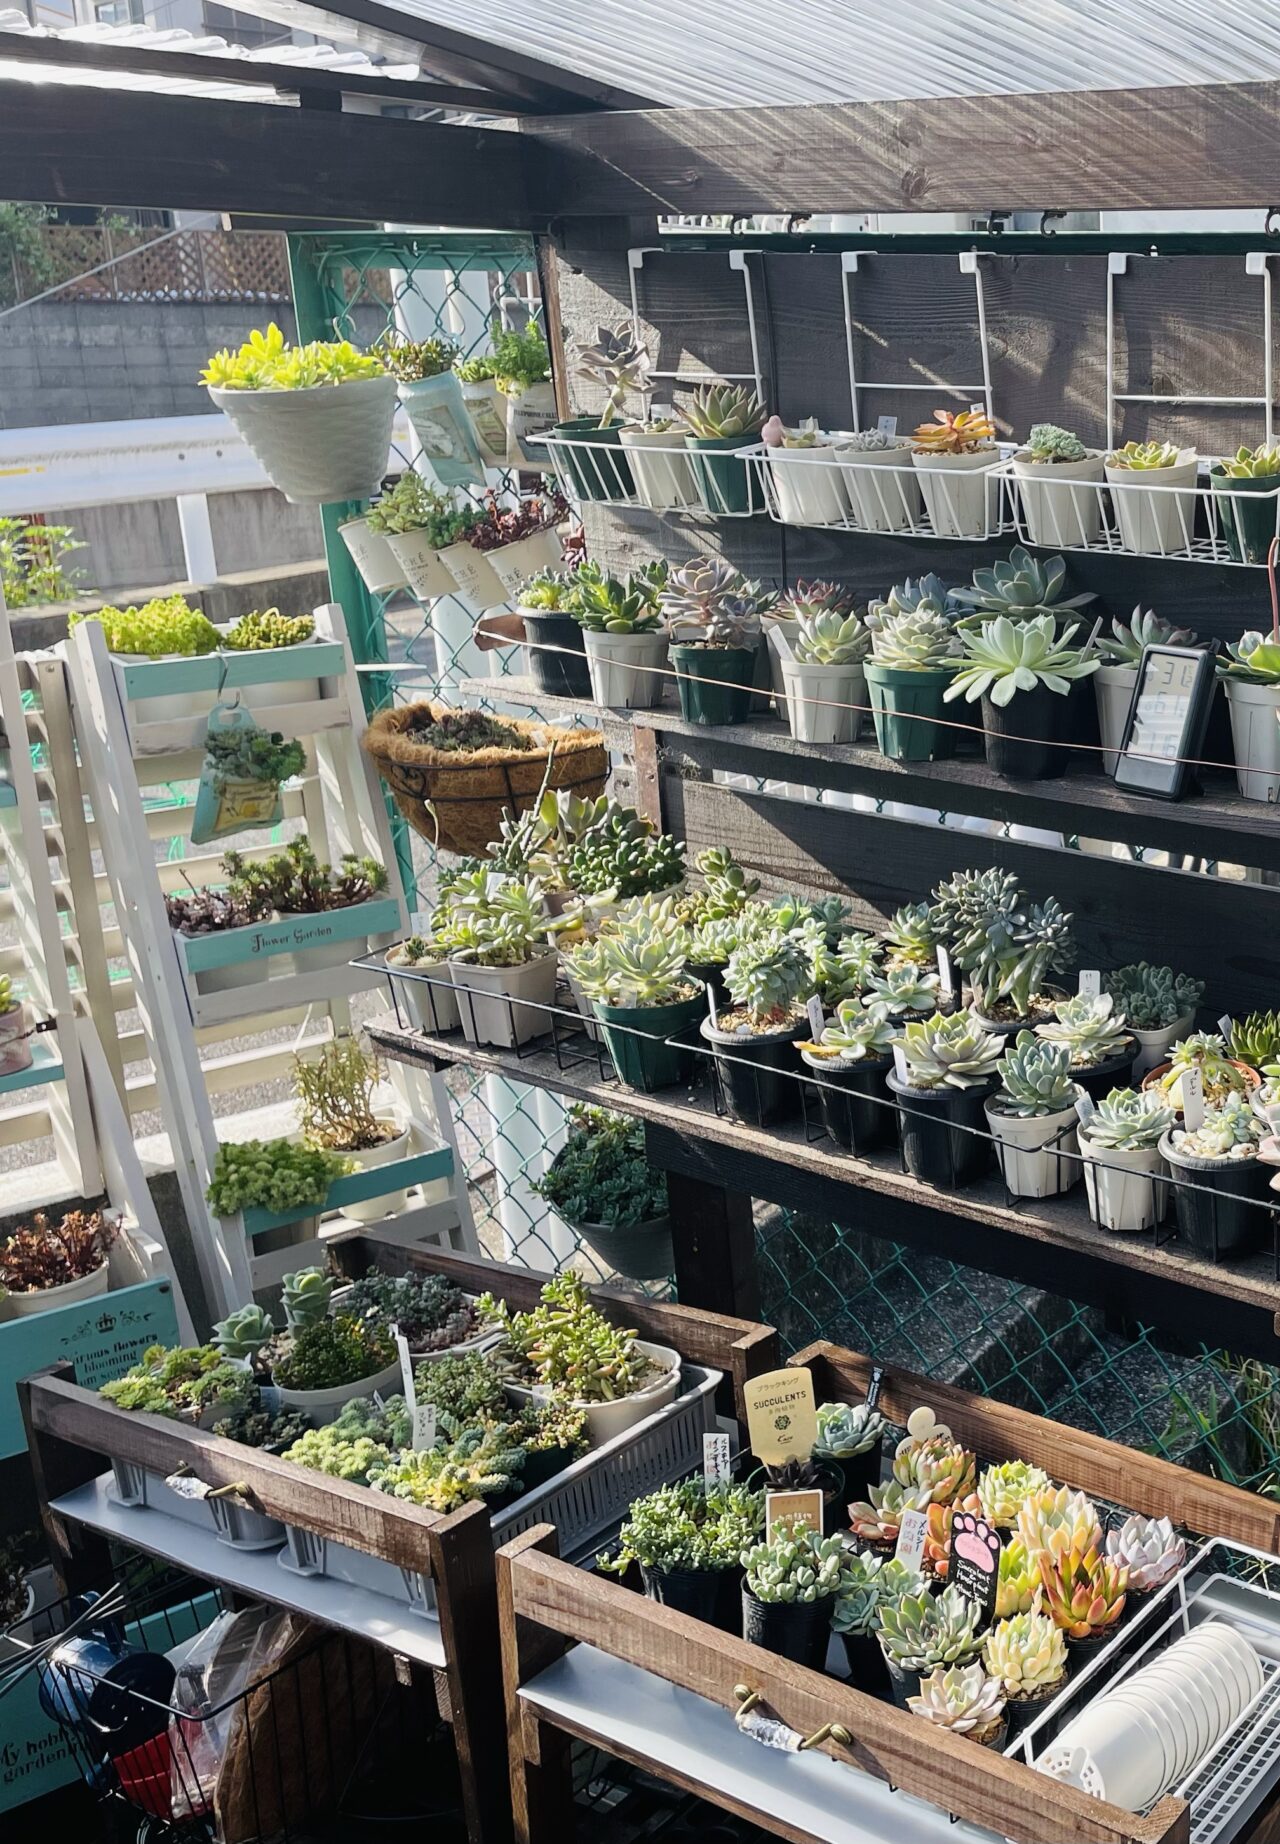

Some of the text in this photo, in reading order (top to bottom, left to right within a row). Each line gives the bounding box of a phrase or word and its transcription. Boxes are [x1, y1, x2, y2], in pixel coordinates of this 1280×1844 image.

[250, 927, 332, 953] Flower Garden
[753, 1390, 807, 1410] SUCCULENTS
